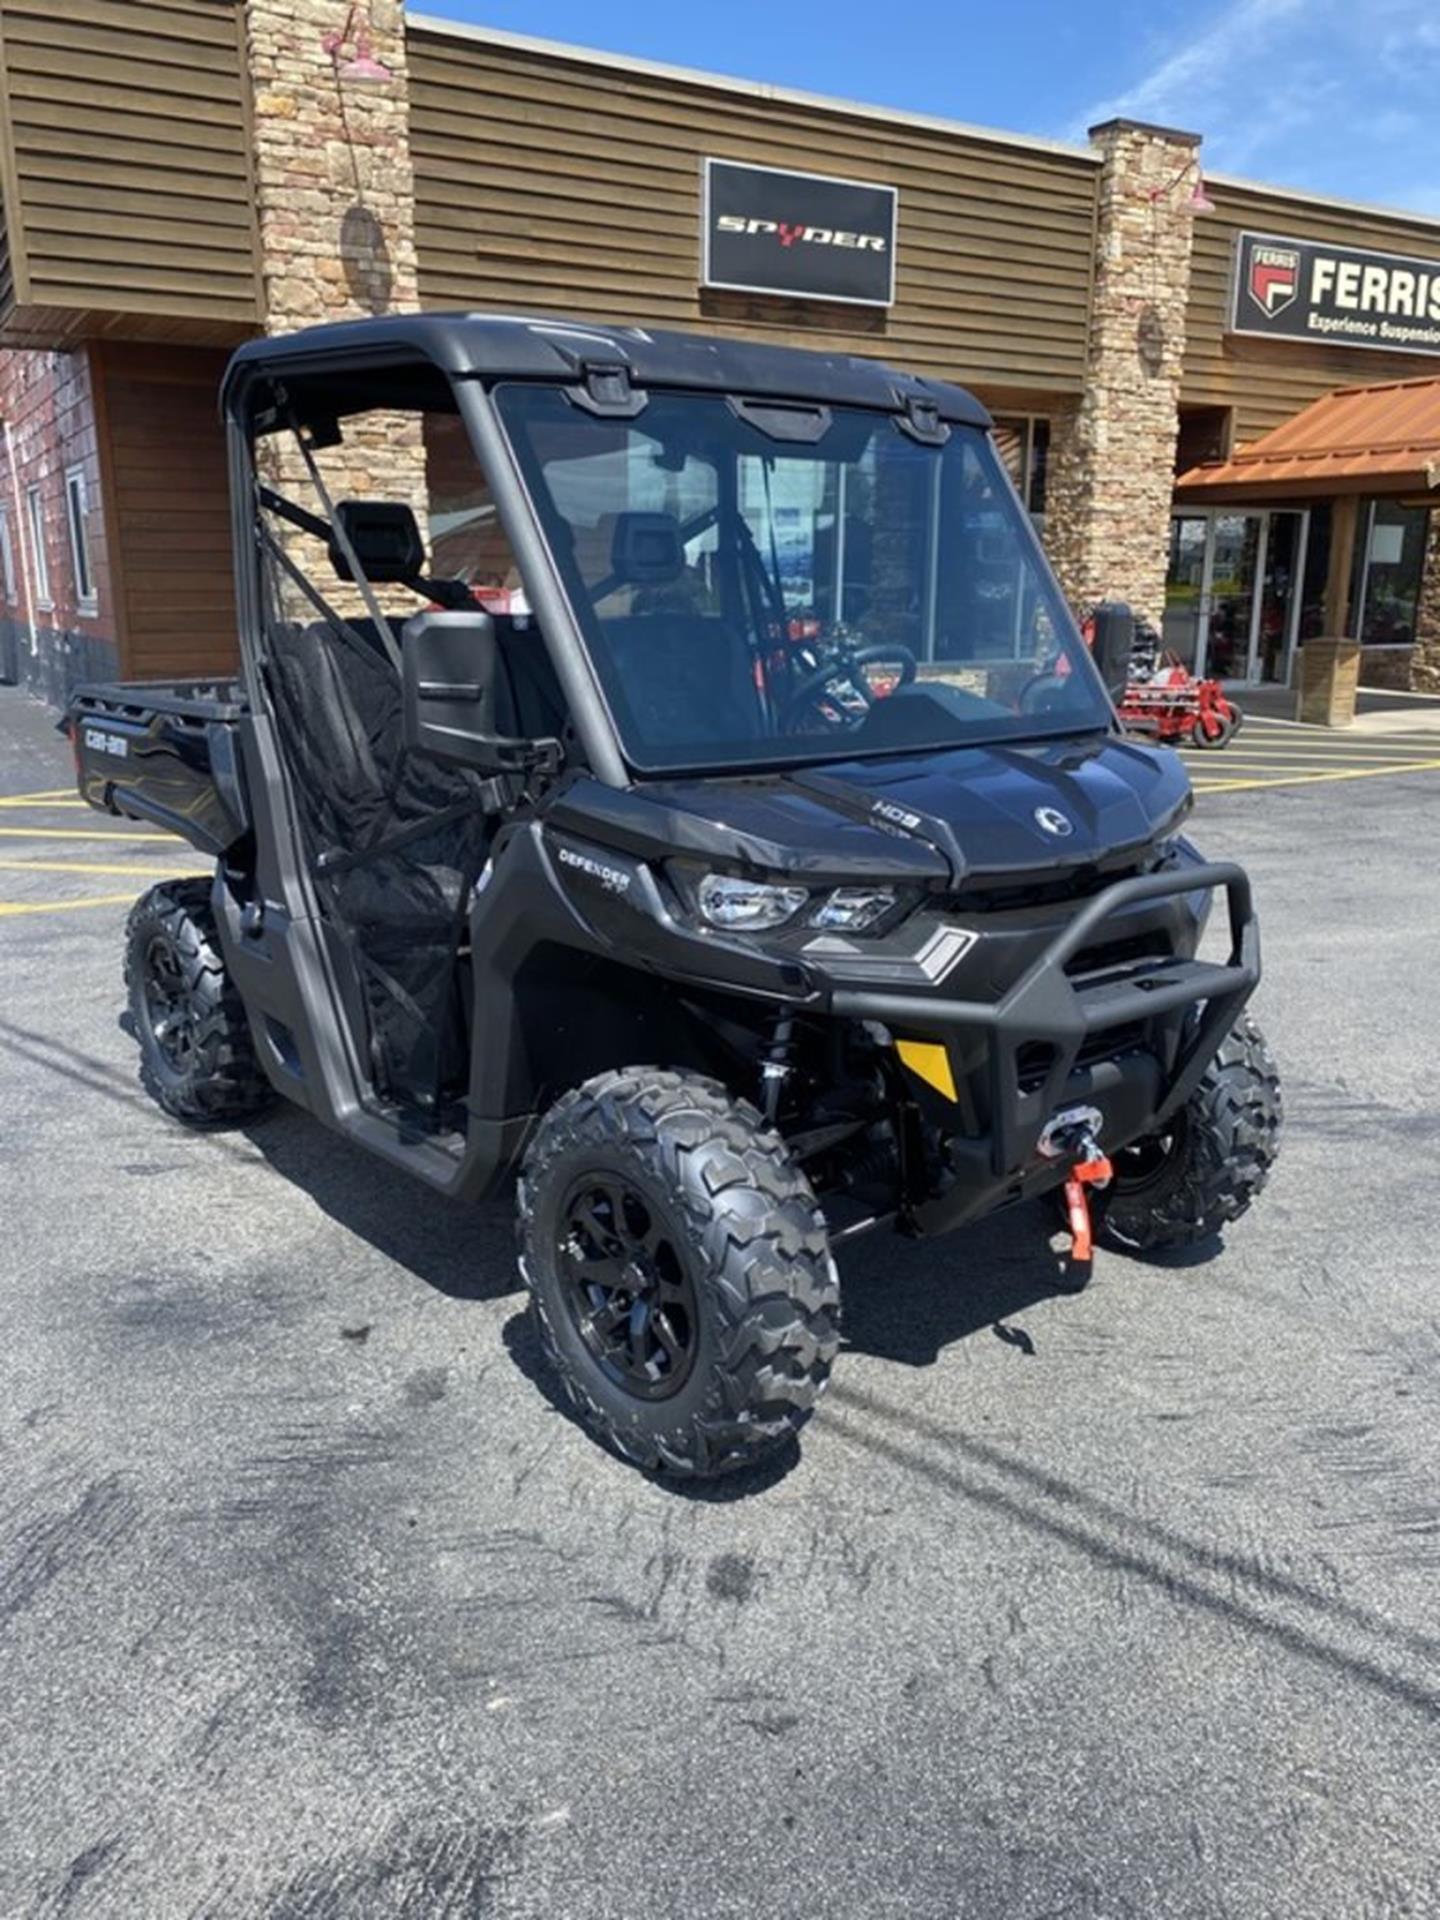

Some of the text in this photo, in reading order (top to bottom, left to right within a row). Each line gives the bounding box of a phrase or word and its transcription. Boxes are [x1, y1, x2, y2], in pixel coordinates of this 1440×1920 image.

[717, 215, 886, 252] SPYDER
[1308, 312, 1377, 334] Experience
[558, 849, 631, 886] DEFENDER
